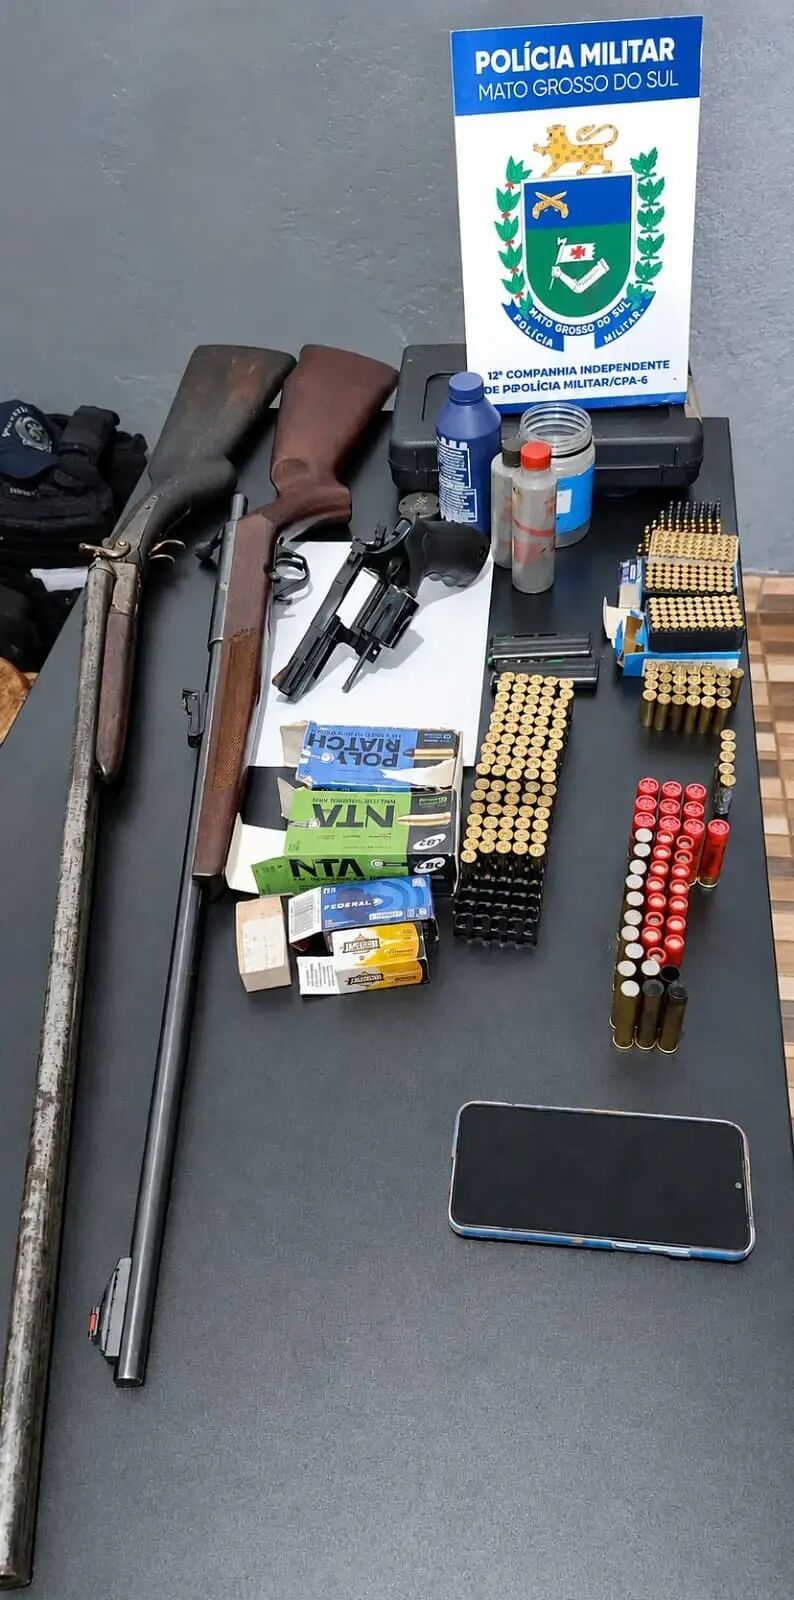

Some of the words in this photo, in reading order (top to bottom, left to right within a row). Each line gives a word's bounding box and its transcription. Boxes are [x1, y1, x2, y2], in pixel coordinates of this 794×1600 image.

[475, 41, 574, 75] POLÍCIA
[580, 37, 675, 67] MILITAR
[479, 80, 528, 100] MATO
[533, 74, 608, 96] GROSSO
[614, 72, 641, 90] DO
[646, 70, 679, 87] SUL
[529, 307, 553, 328] MATO
[555, 323, 595, 335] GROSSO
[597, 316, 610, 328] DO
[612, 301, 632, 318] SUL
[506, 366, 577, 379] COMPANHIA
[580, 360, 670, 375] INDEPENDENTE
[484, 386, 500, 395] DE
[563, 375, 648, 390] MILITAR/CPA-6
[312, 803, 395, 828] NTA
[289, 858, 365, 877] NTA
[323, 900, 371, 911] FEDERAL
